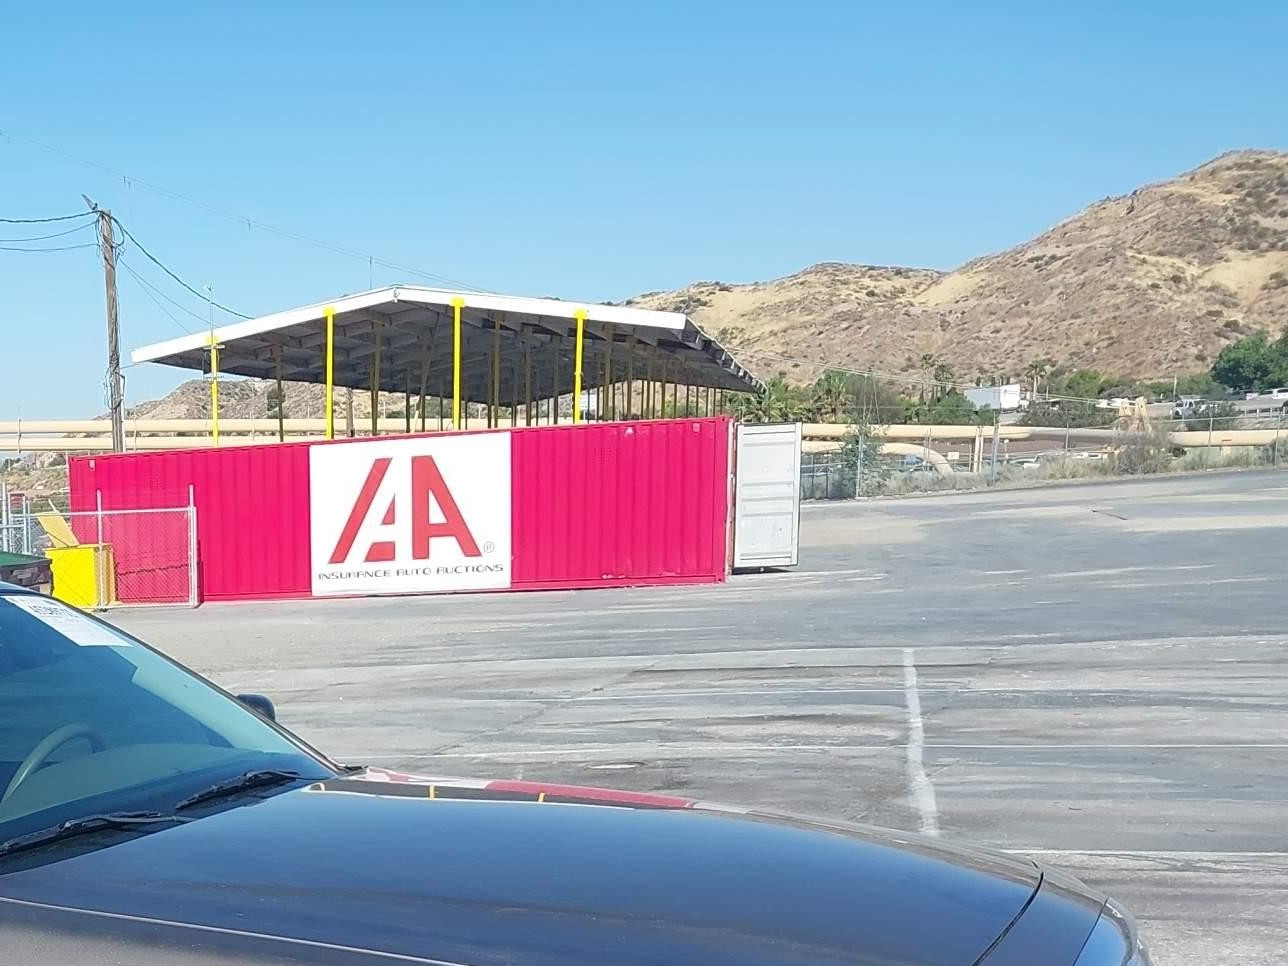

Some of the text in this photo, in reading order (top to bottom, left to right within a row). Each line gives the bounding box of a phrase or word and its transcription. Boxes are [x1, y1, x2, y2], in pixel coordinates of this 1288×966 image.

[318, 564, 504, 580] INSURANCE AUTO AUCTIONS
